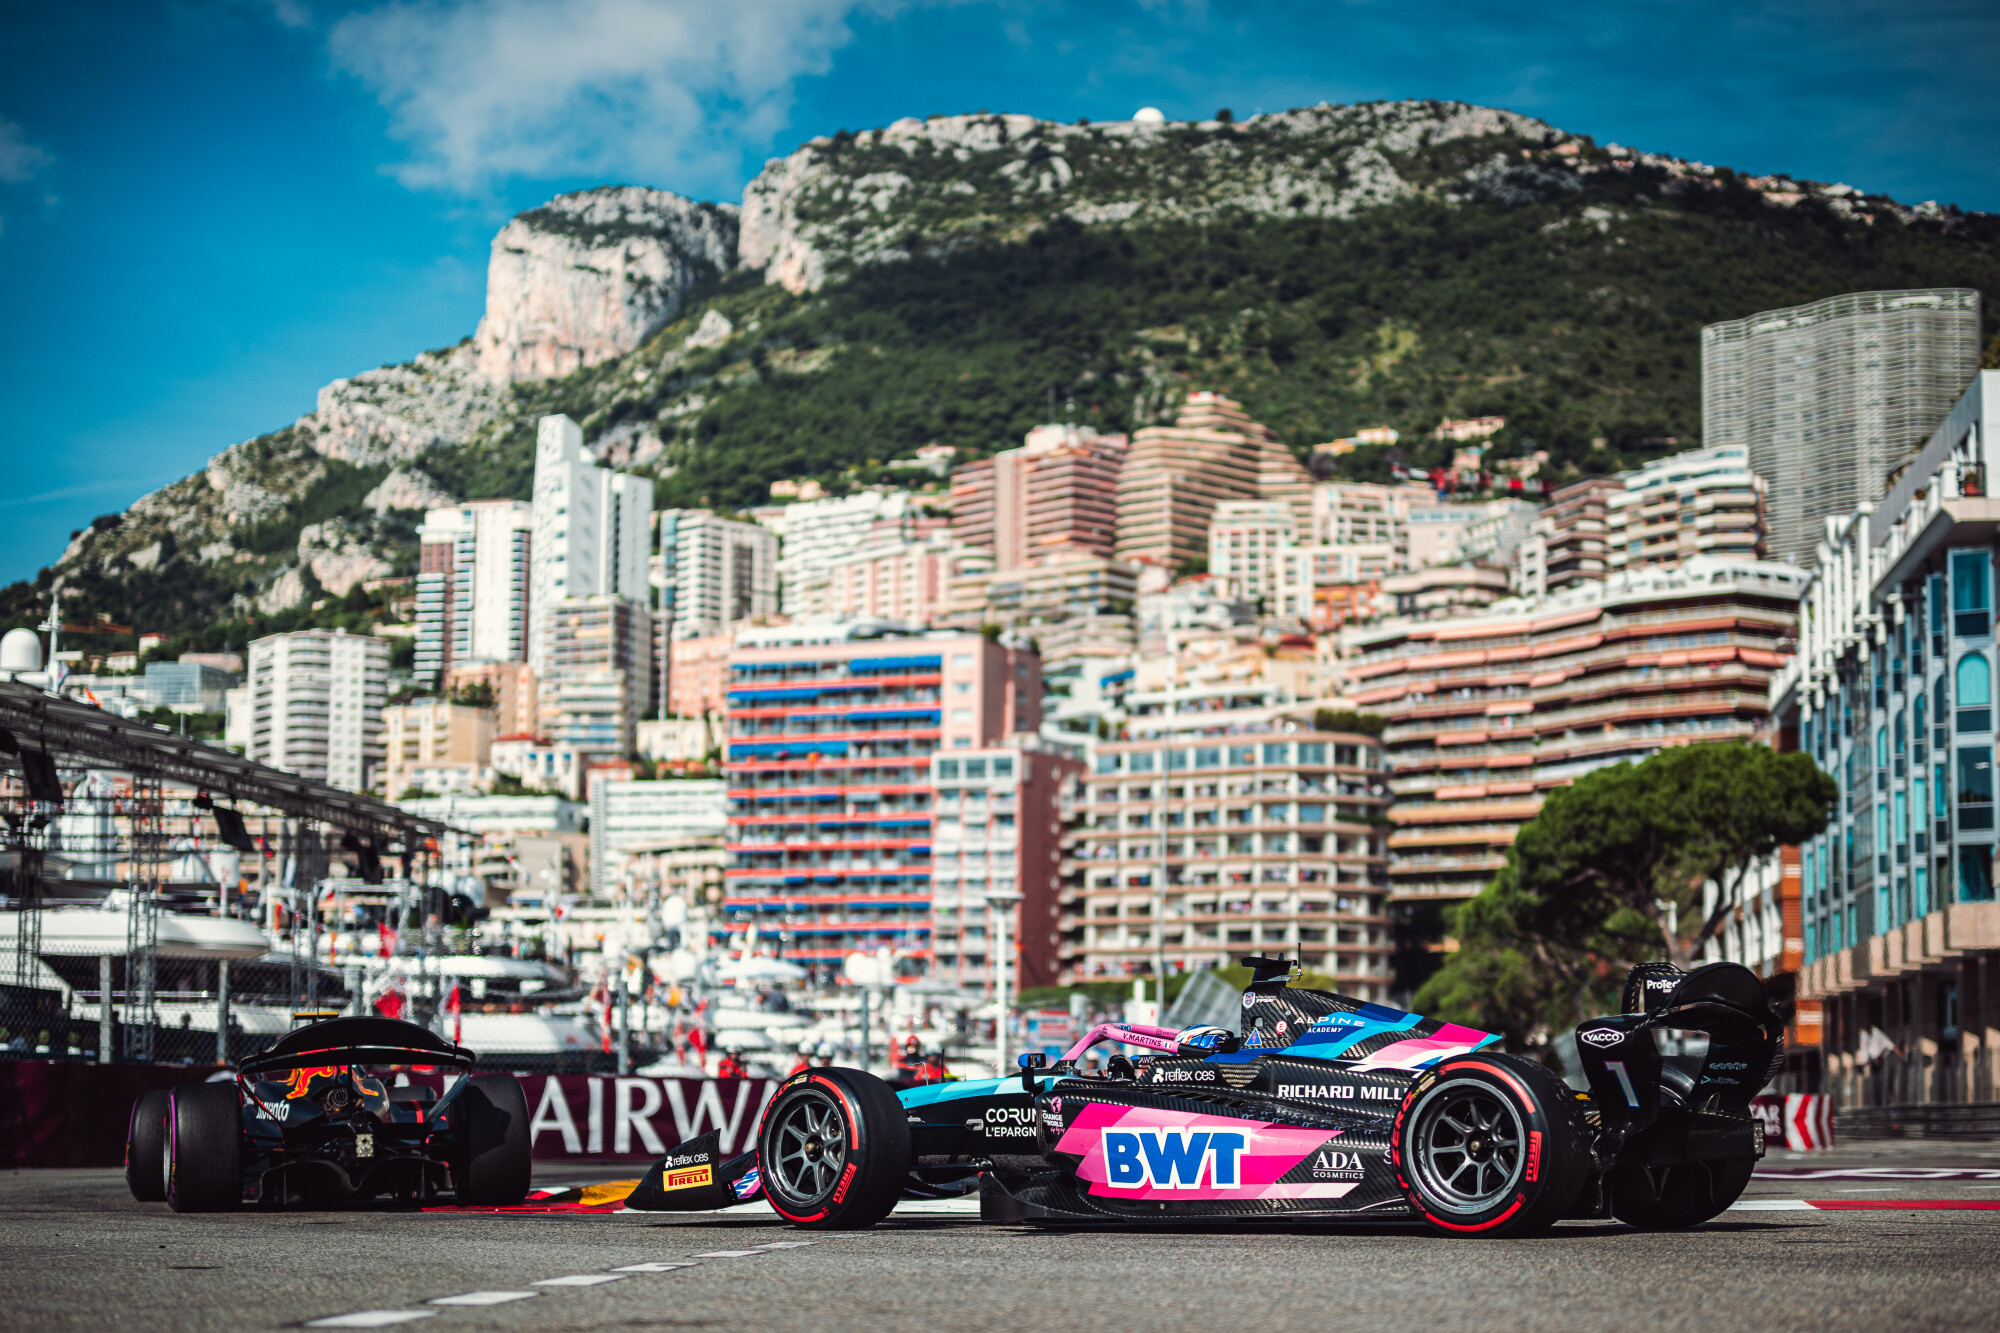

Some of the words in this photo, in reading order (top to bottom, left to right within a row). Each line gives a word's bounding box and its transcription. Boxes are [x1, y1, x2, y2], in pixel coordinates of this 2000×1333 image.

[1294, 1016, 1366, 1027] ALPINE
[1123, 1033, 1162, 1047] V.MARTINS
[1586, 1033, 1619, 1042] YACCO
[1165, 1068, 1193, 1081] reflex
[1195, 1070, 1215, 1081] ces
[1278, 1084, 1354, 1099] RICHARD
[1360, 1086, 1408, 1100] MILL
[1604, 1061, 1640, 1108] 1
[673, 1155, 693, 1167] reflex
[694, 1153, 709, 1164] ces
[1103, 1129, 1249, 1187] BWT
[1313, 1151, 1365, 1169] ADA
[1525, 1130, 1543, 1183] PIRELLI
[668, 1168, 709, 1187] PIRELLI
[1313, 1171, 1364, 1179] COSMETICS
[832, 1162, 858, 1205] PIRELLI
